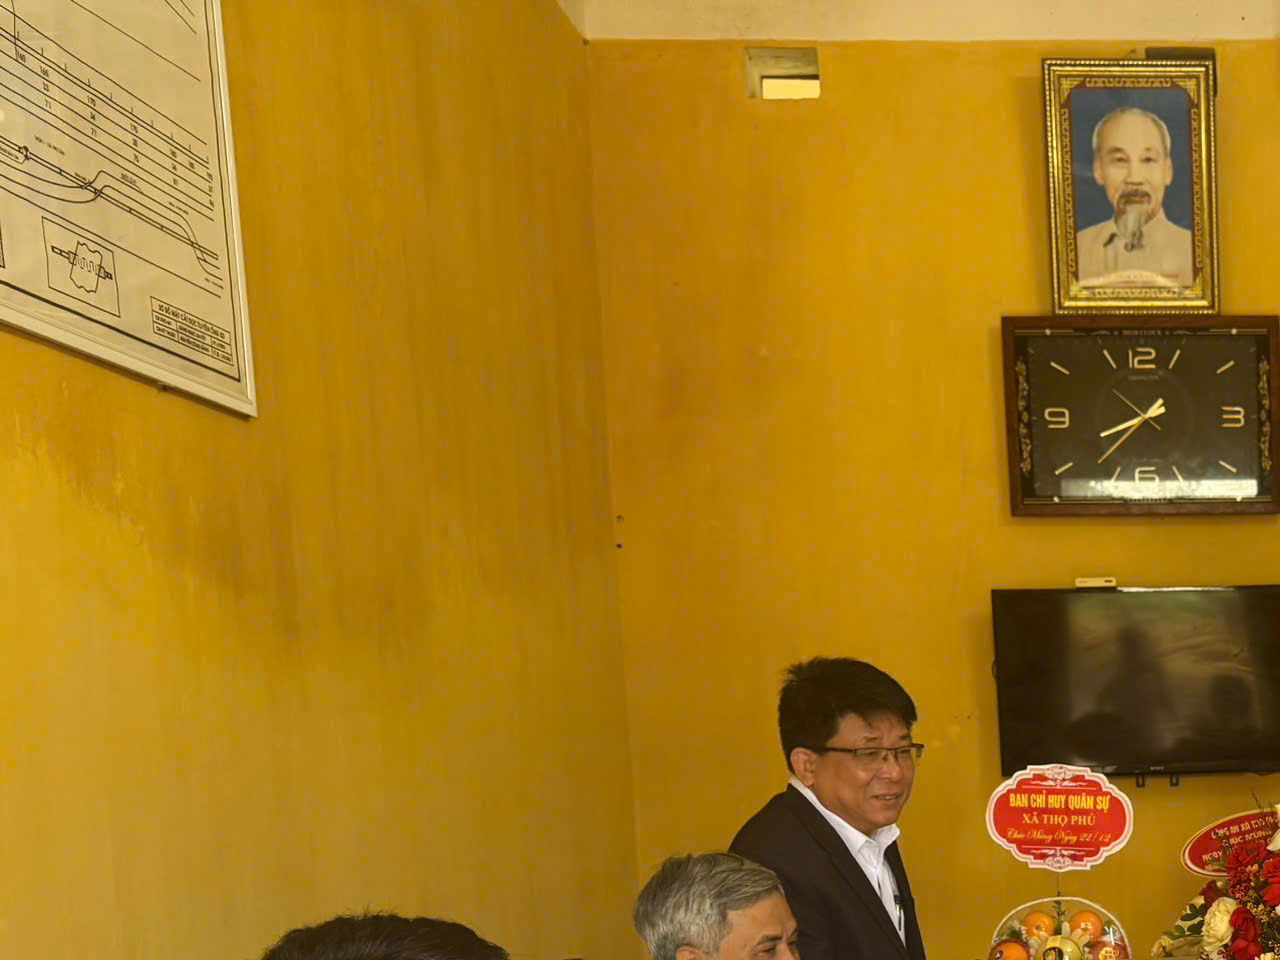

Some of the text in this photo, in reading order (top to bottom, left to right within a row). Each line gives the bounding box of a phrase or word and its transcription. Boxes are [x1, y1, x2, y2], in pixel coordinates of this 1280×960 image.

[1128, 347, 1156, 369] 12
[1044, 406, 1245, 429] 9 3
[1009, 789, 1111, 813] BAN CHỈ HUY QUÂN SỰ
[1022, 811, 1096, 827] XÃ THỌ PHÚ
